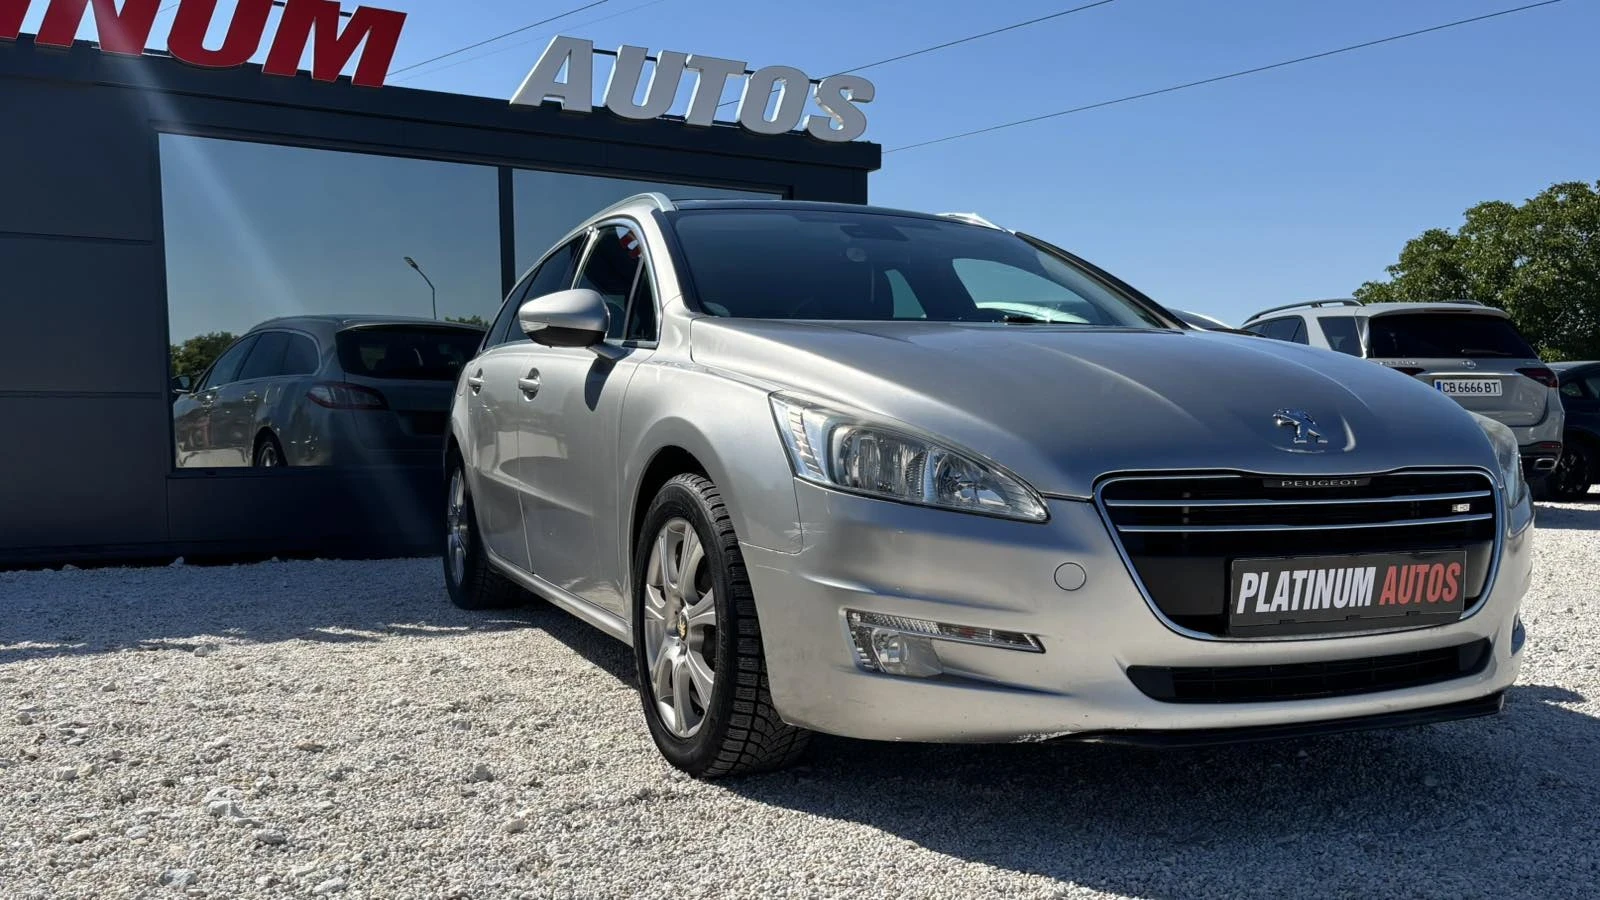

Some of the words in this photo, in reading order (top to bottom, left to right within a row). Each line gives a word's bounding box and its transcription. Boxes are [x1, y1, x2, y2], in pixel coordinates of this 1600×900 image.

[509, 34, 875, 142] AUTOS
[1443, 382, 1456, 393] CB
[1458, 382, 1483, 393] 6666
[1484, 382, 1498, 393] BT
[1281, 479, 1359, 487] PEUGEOT
[1236, 566, 1377, 614] PLATINUM
[1379, 562, 1461, 606] AUTOS
